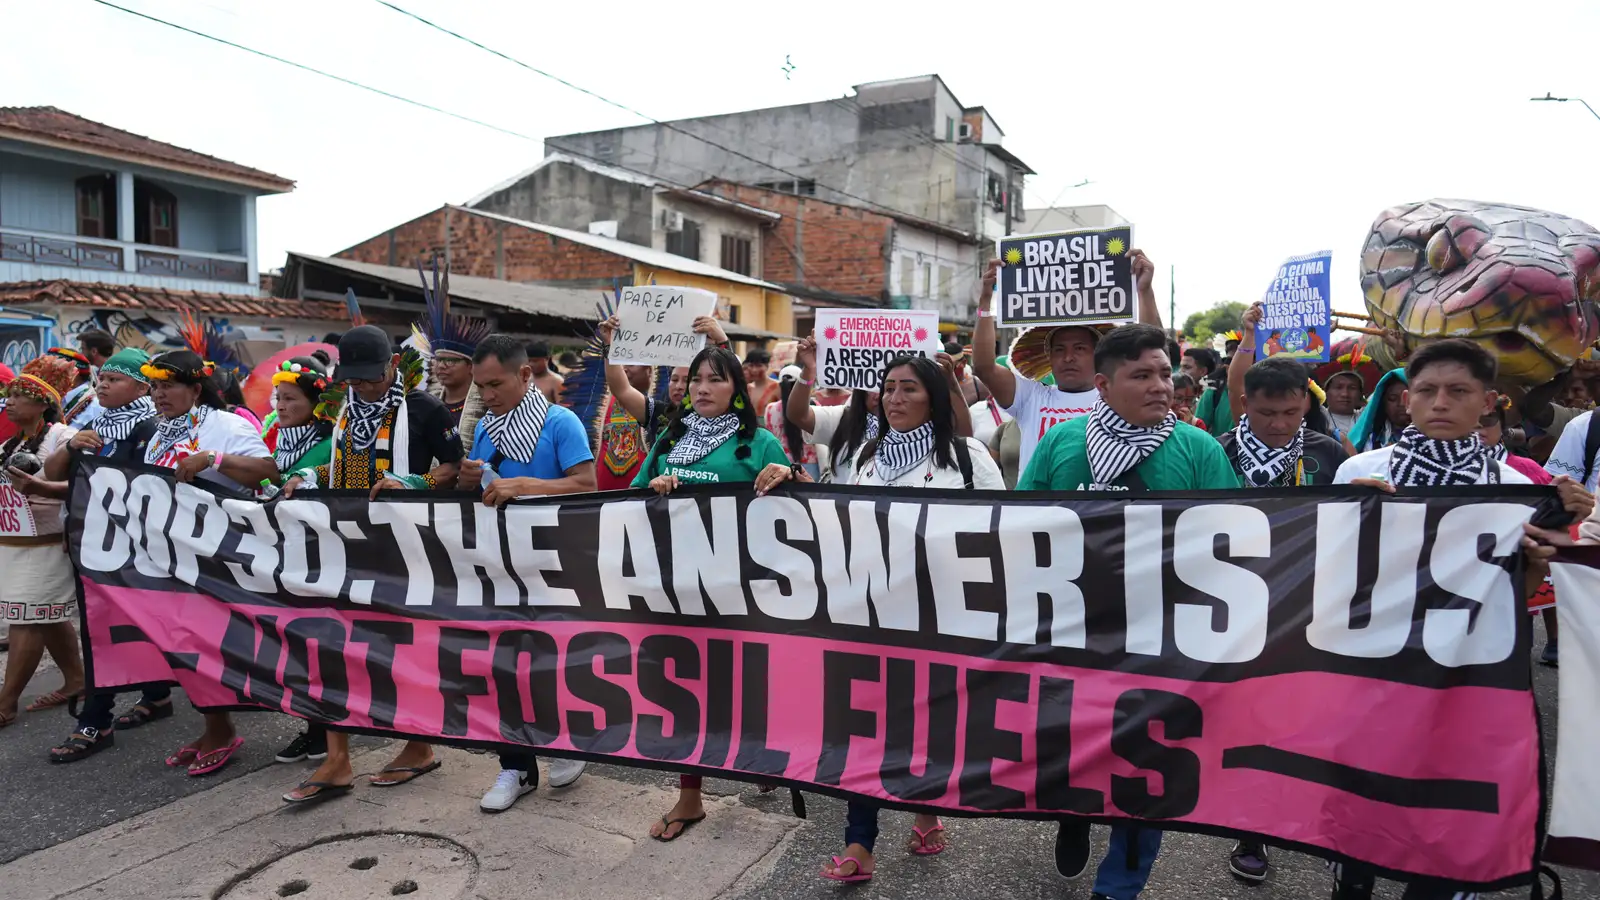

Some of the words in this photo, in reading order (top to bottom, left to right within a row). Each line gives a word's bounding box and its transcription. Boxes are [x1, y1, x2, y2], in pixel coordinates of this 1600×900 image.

[1024, 235, 1105, 266] BRASIL
[1016, 263, 1080, 292] LIVRE
[1083, 260, 1115, 288] DE
[1288, 260, 1324, 276] CLIMA
[1281, 275, 1309, 291] PELA
[624, 290, 684, 309] PAREM
[1266, 299, 1326, 317] RESPOSTA
[646, 310, 667, 323] DE
[839, 316, 912, 331] EMERGÊNCIA
[1258, 314, 1301, 331] SOMOS
[613, 330, 640, 342] NOS
[839, 329, 912, 348] CLIMÁTICA
[612, 346, 634, 359] SOS
[825, 348, 837, 366] A
[663, 467, 670, 475] A
[671, 467, 719, 482] RESPOSTA
[80, 467, 376, 602] COP30:
[368, 502, 580, 606] THE
[598, 497, 1086, 649] ANSWER
[1124, 504, 1270, 663] IS
[1306, 502, 1537, 667] US
[219, 613, 413, 728] NOT
[438, 627, 789, 776] FOSSIL
[814, 650, 1201, 819] FUELS
